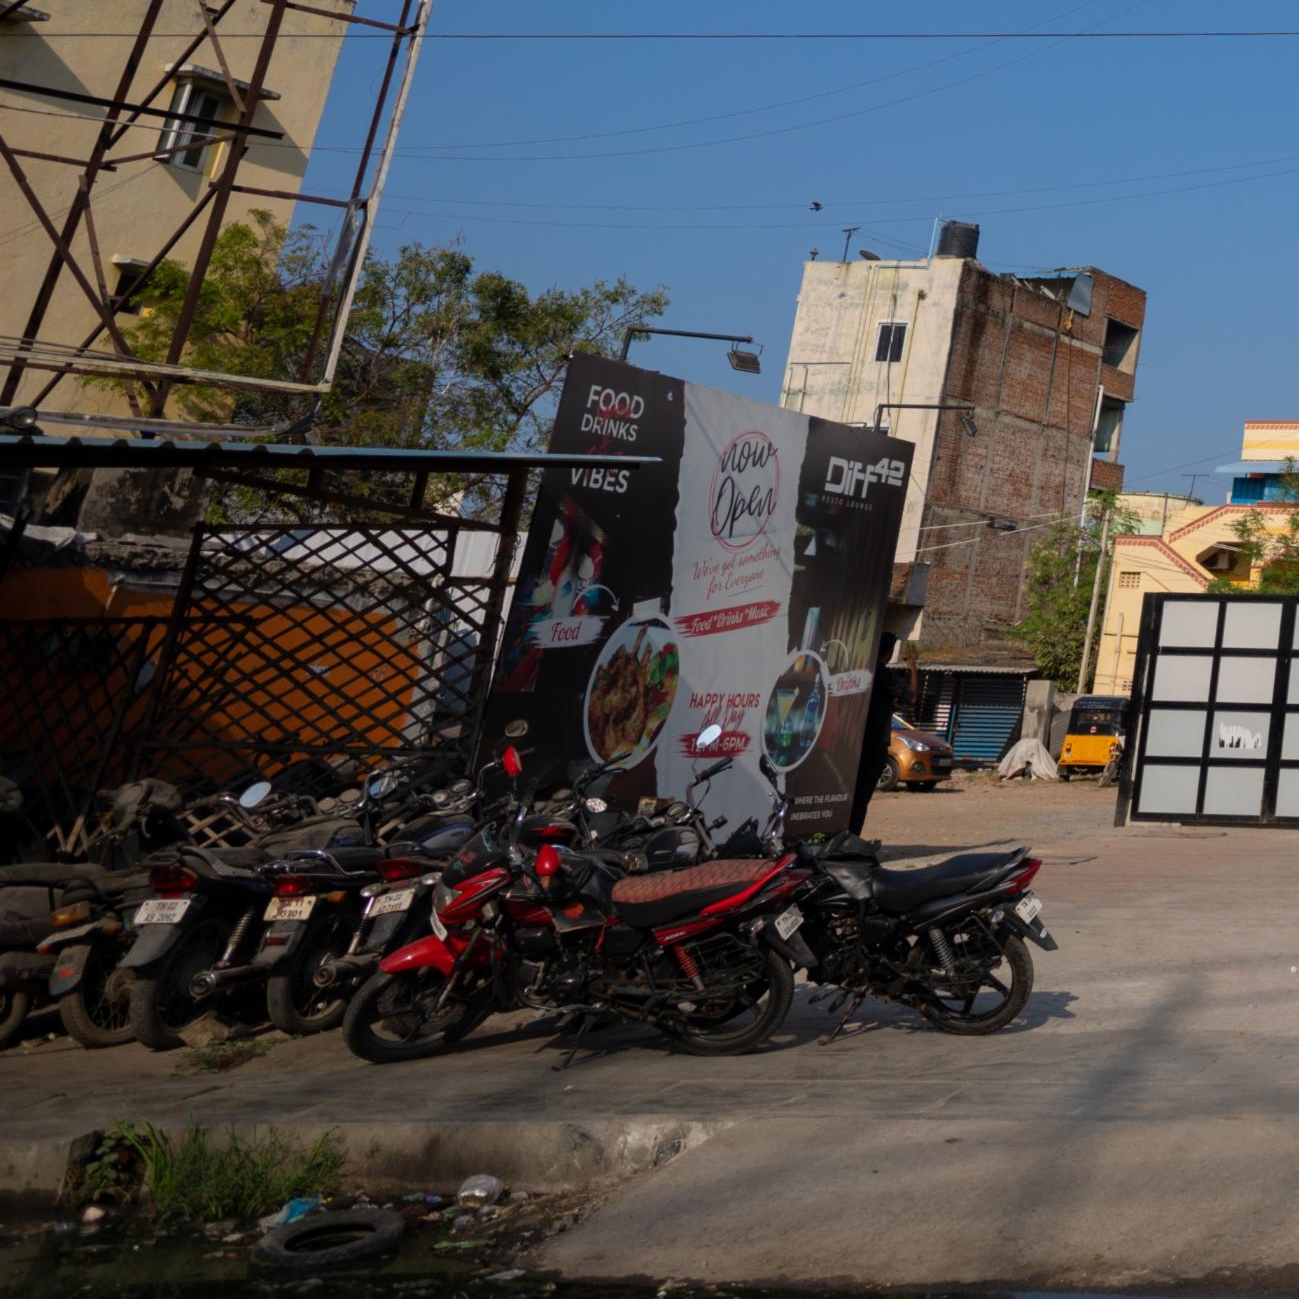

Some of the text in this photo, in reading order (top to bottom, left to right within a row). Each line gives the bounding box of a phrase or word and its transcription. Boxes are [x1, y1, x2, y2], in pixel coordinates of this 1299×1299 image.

[586, 384, 645, 419] FOOD
[580, 413, 638, 442] DRINKS
[571, 467, 630, 494] VIBES
[711, 476, 776, 539] Open
[552, 621, 582, 642] Food
[836, 675, 861, 693] Drinks
[689, 693, 760, 708] HAPPY HOURS
[825, 793, 849, 804] FLAVOUR
